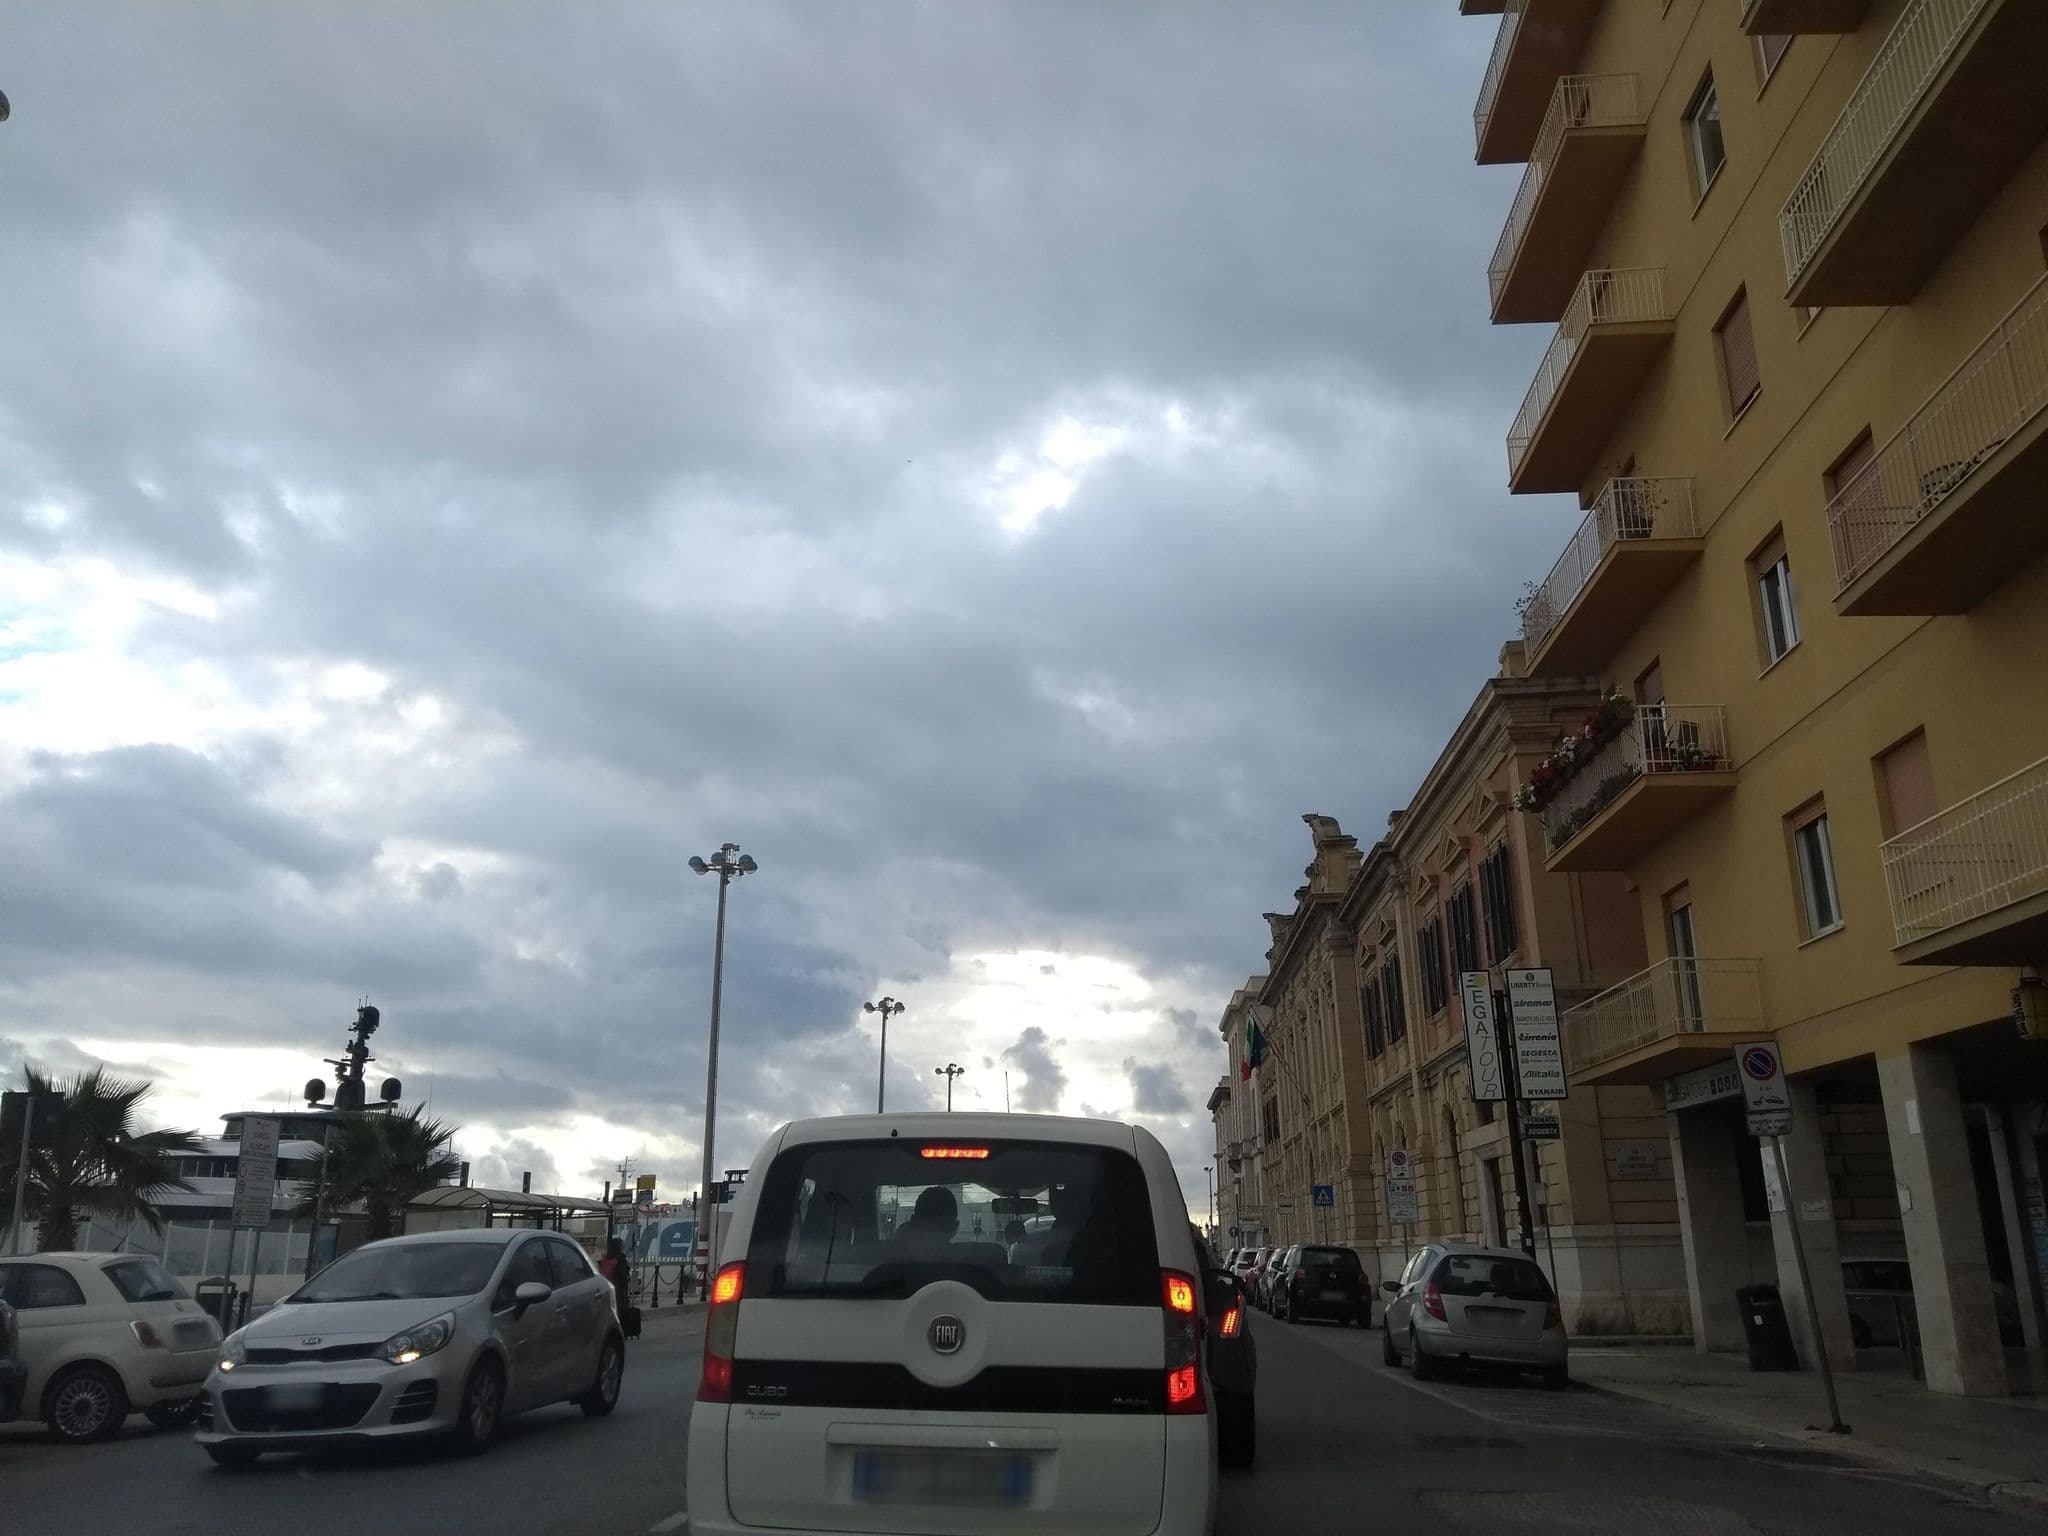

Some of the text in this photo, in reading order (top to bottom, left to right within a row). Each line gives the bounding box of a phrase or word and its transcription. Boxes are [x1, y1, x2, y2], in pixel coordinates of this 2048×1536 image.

[1513, 1000, 1553, 1008] siremar
[1522, 1070, 1560, 1079] Alitalia
[936, 1325, 957, 1344] FIAT
[747, 1385, 787, 1396] QUBO
